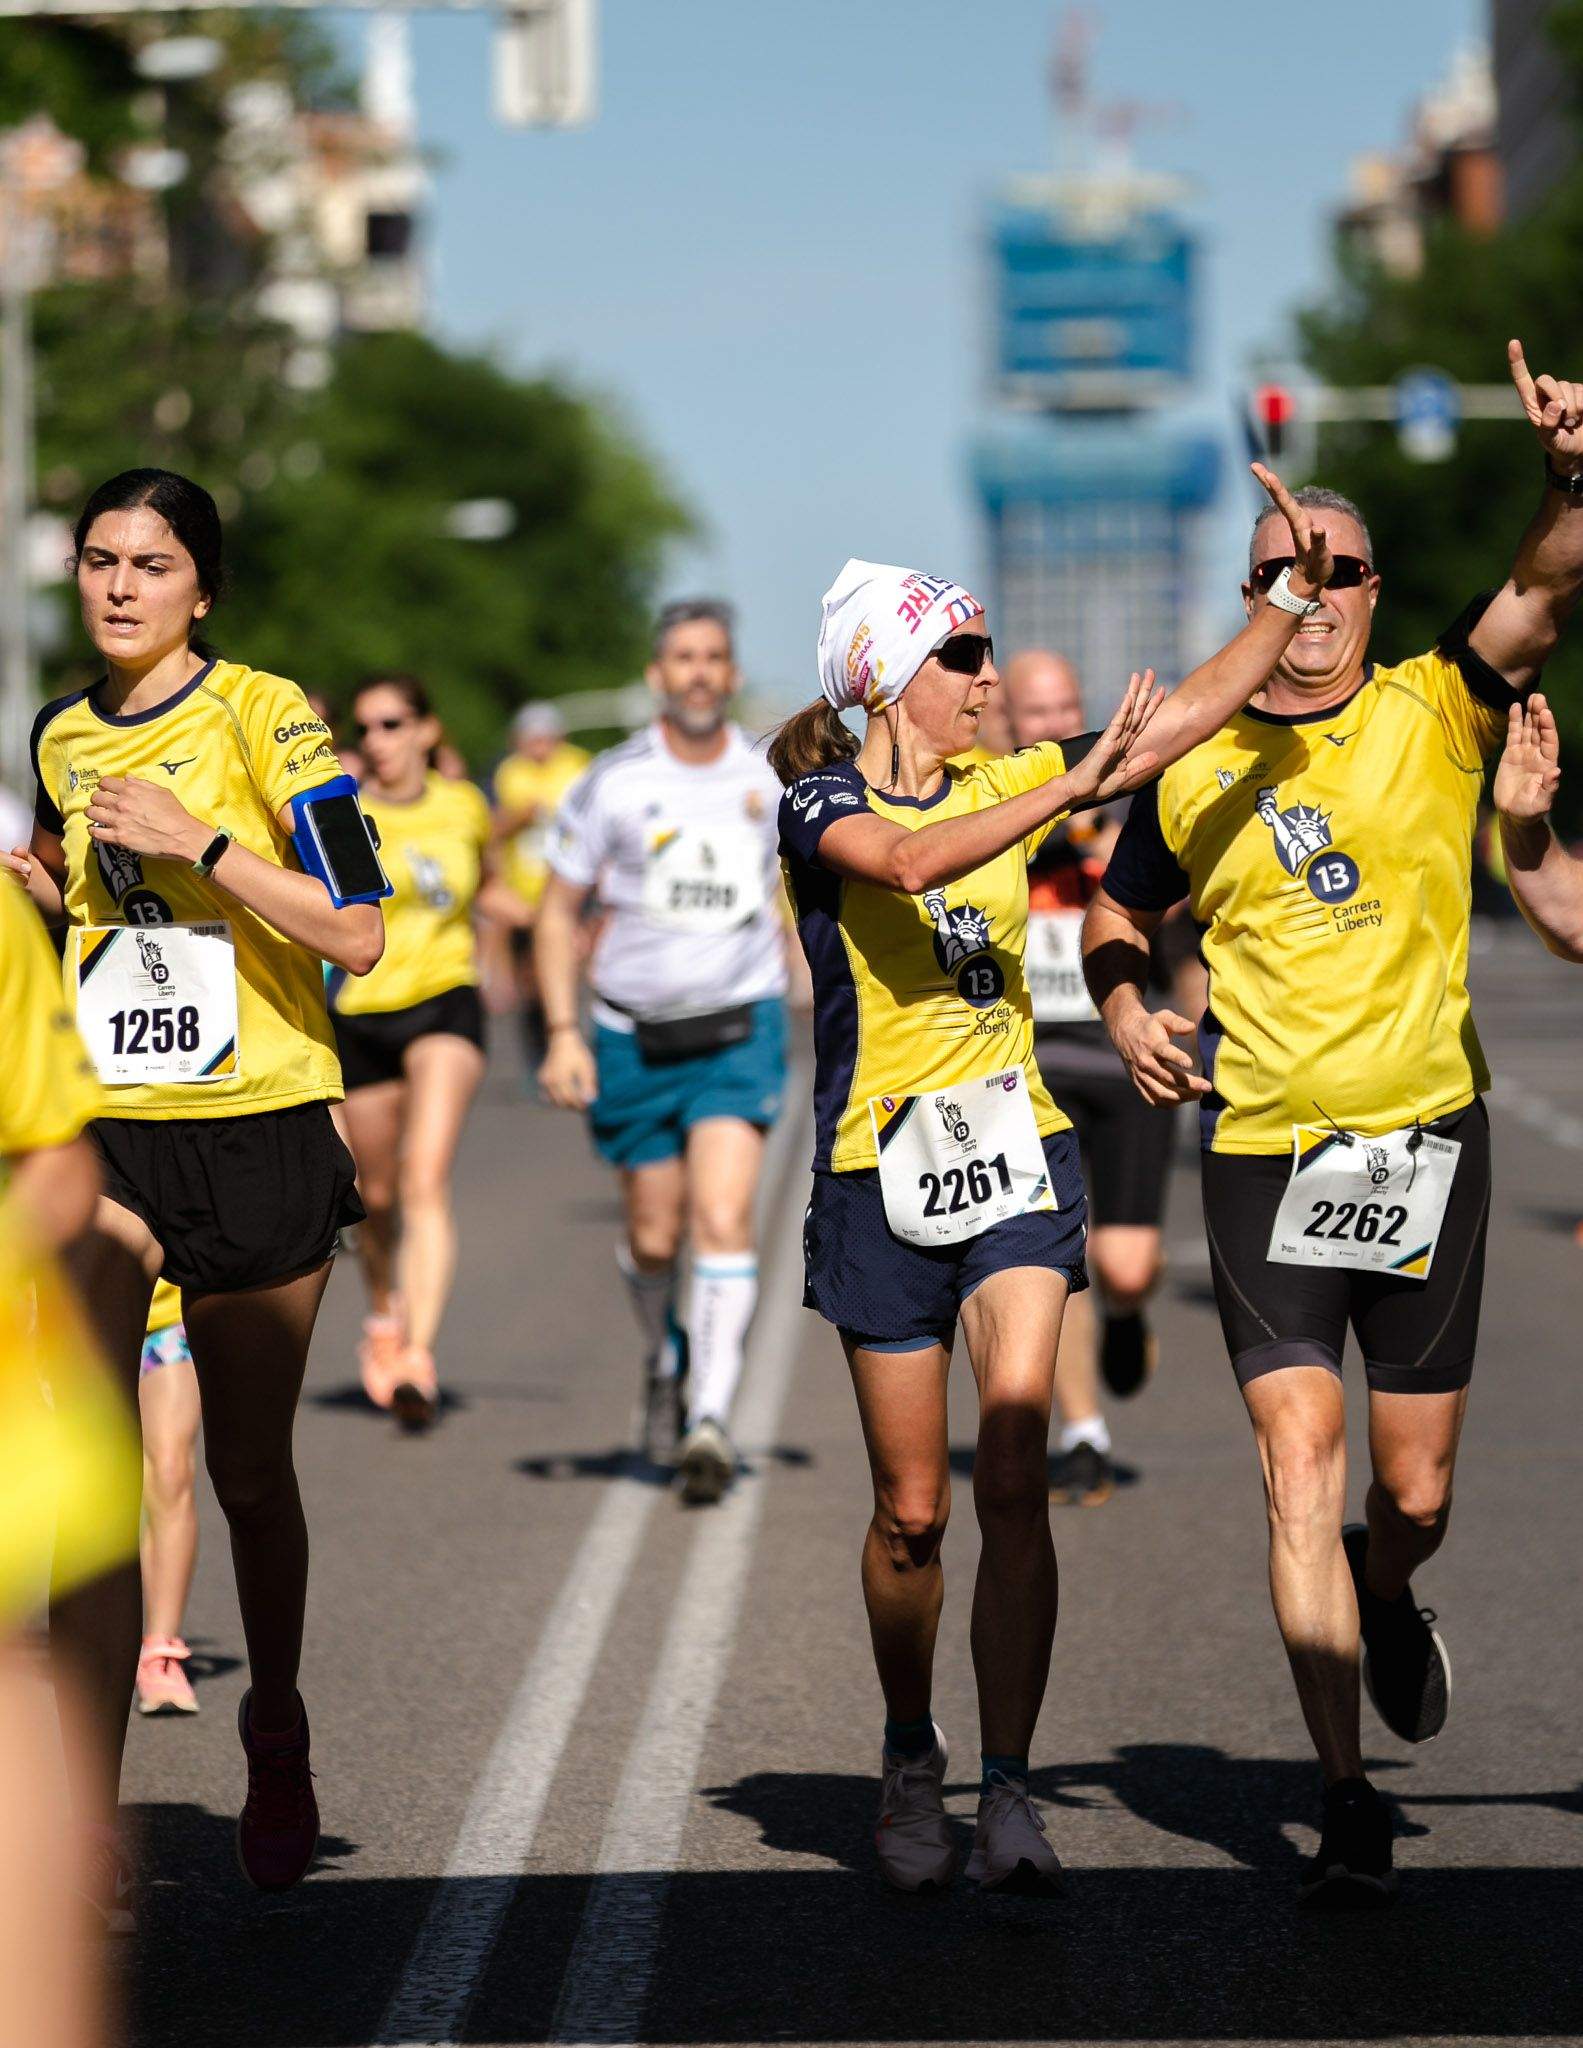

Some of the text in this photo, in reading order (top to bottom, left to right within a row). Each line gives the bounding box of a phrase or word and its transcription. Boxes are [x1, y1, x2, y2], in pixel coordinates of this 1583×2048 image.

[273, 717, 328, 744] Génesis
[1315, 862, 1350, 893] 13
[131, 901, 164, 926] 13
[1332, 899, 1381, 919] Carrera
[1336, 913, 1383, 933] Liberty
[153, 968, 167, 980] 13
[967, 968, 995, 996] 13
[108, 1005, 200, 1055] 1258
[956, 1125, 968, 1139] 13
[919, 1152, 1014, 1218] 2261
[1374, 1170, 1387, 1181] 13
[1303, 1200, 1408, 1247] 2262
